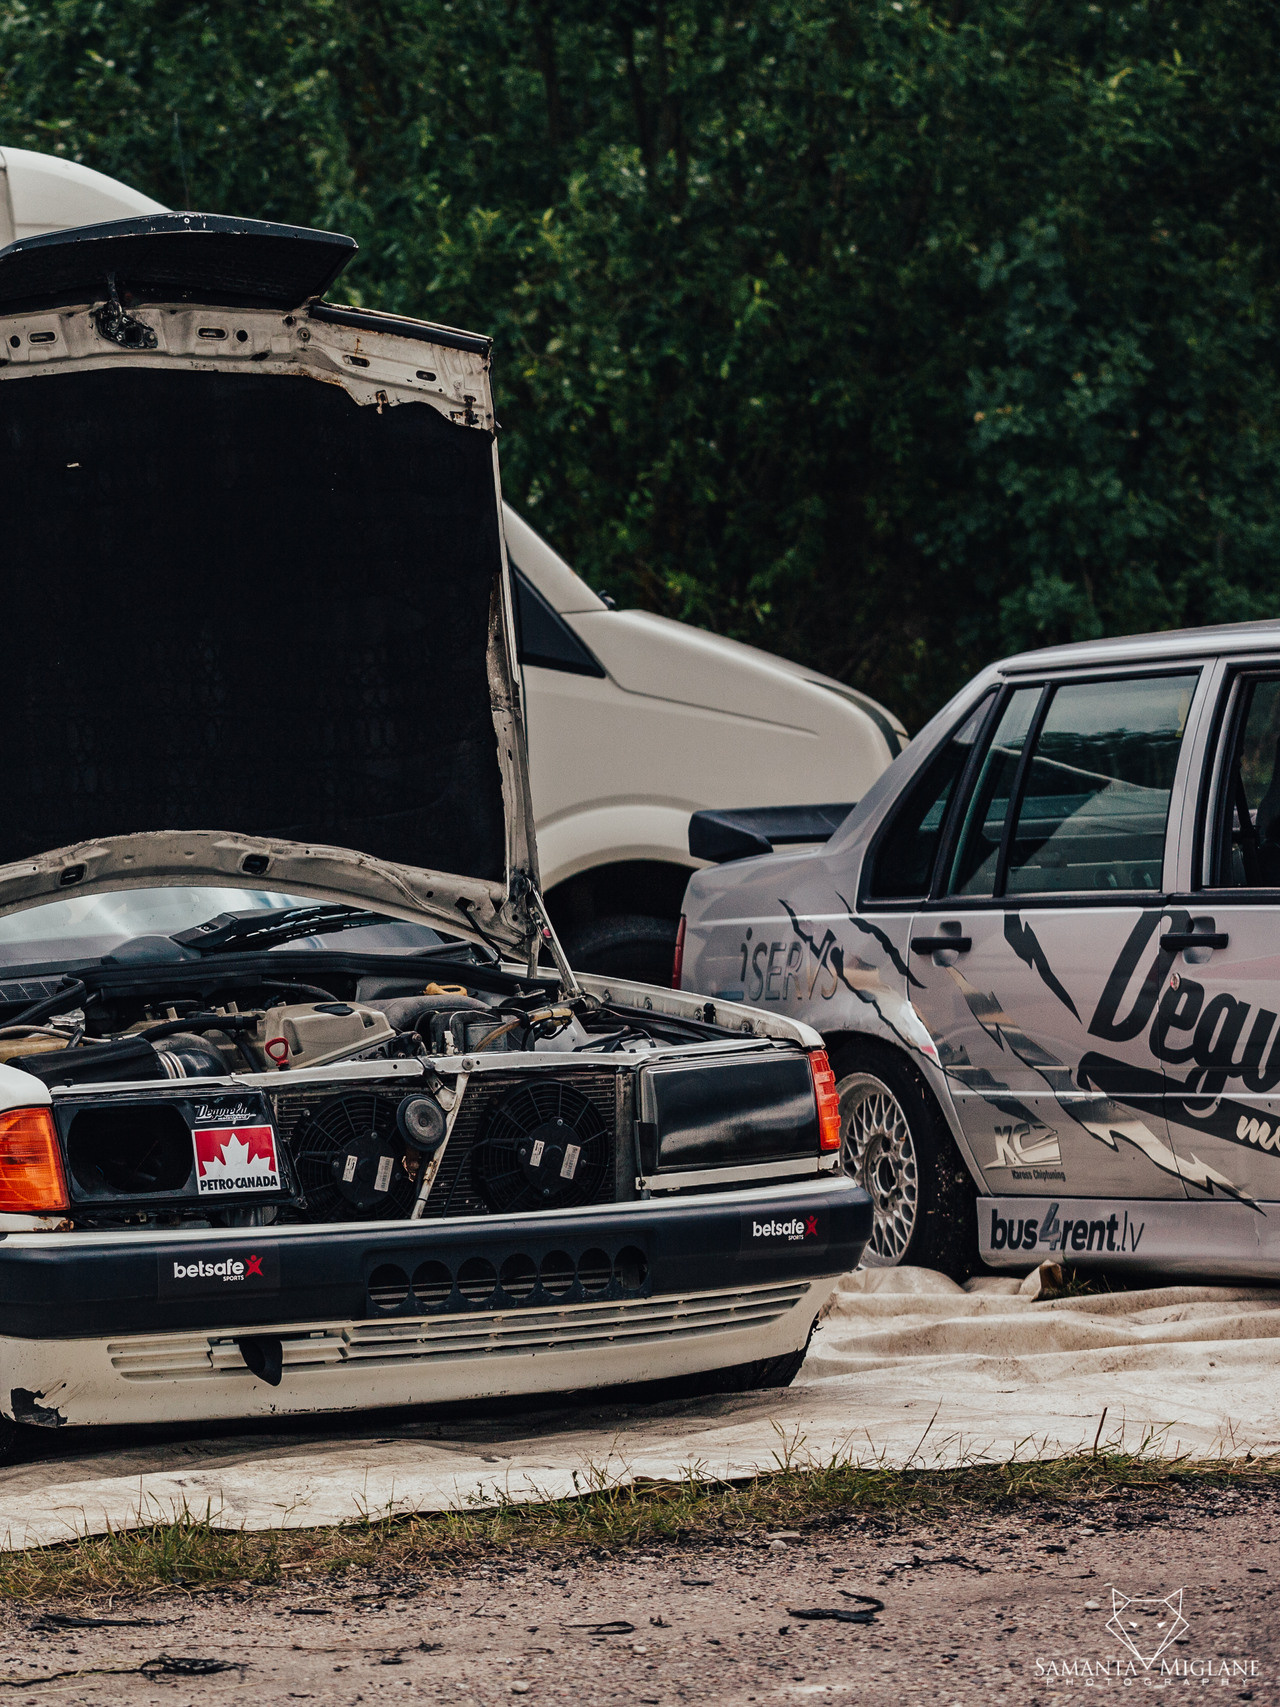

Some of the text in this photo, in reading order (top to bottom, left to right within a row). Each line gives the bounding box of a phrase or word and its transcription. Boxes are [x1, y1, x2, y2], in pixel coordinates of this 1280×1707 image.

[752, 1218, 805, 1237] betsafe
[990, 1202, 1145, 1252] bus4rent.lv
[173, 1258, 244, 1279] betsafe
